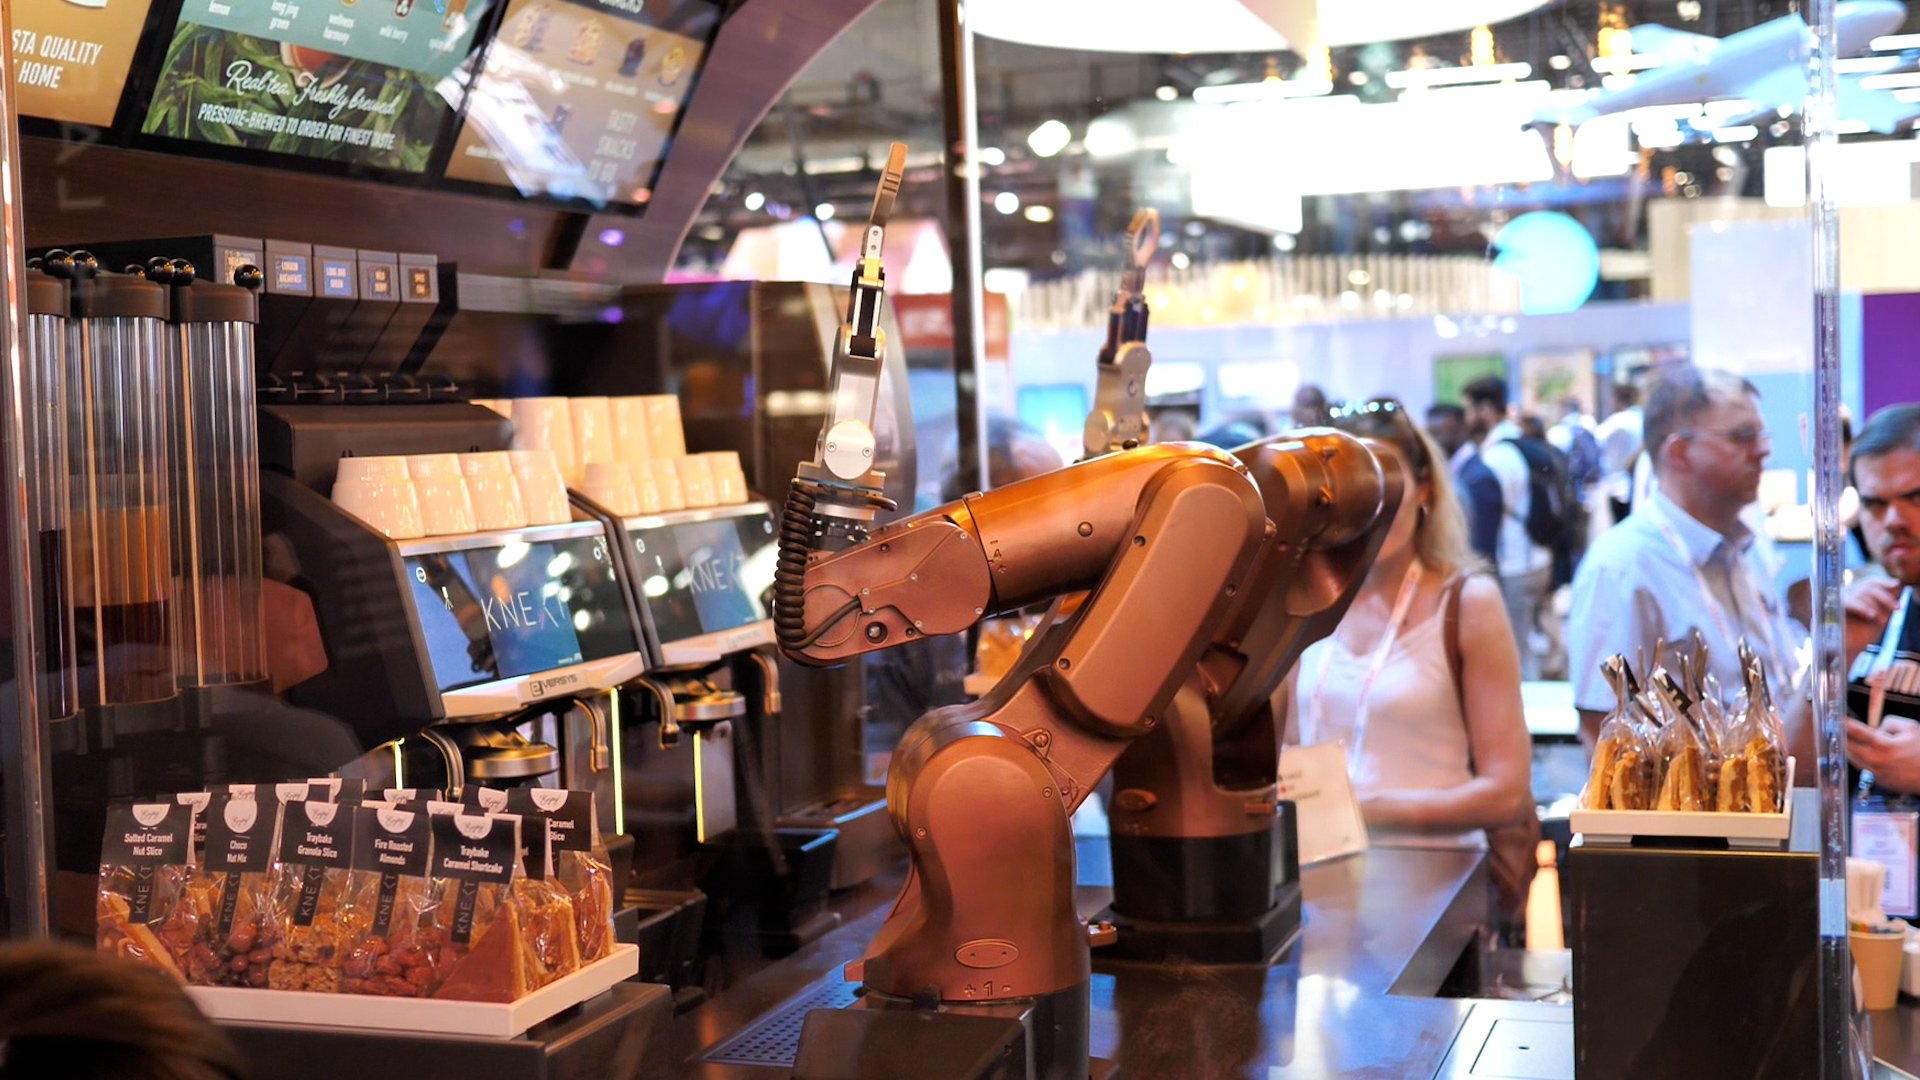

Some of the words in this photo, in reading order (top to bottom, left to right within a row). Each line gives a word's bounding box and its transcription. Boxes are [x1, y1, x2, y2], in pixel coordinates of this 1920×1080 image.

[40, 34, 103, 66] QUALITY
[18, 60, 64, 88] HOME
[226, 60, 271, 96] Real
[293, 71, 350, 119] Freshly
[197, 103, 287, 133] PRESSURE-BREWED
[285, 117, 299, 133] TO
[297, 118, 329, 139] ORDER
[326, 122, 345, 142] FOR
[342, 126, 373, 147] FINEST
[549, 818, 575, 829] Caramel
[124, 832, 146, 843] Salted
[146, 832, 173, 843] Caramel
[229, 839, 248, 850] Choco
[306, 831, 333, 845] Traybake
[132, 846, 146, 856] Nut
[146, 846, 163, 856] Slice
[297, 845, 322, 857] Granola
[322, 847, 338, 859] Slice
[374, 838, 388, 850] Fire
[388, 840, 414, 853] Roasted
[460, 845, 490, 858] Traybake
[226, 852, 238, 863] Nut
[379, 853, 406, 866] Almonds
[443, 857, 471, 870] Caramel
[470, 860, 504, 874] Shortcake
